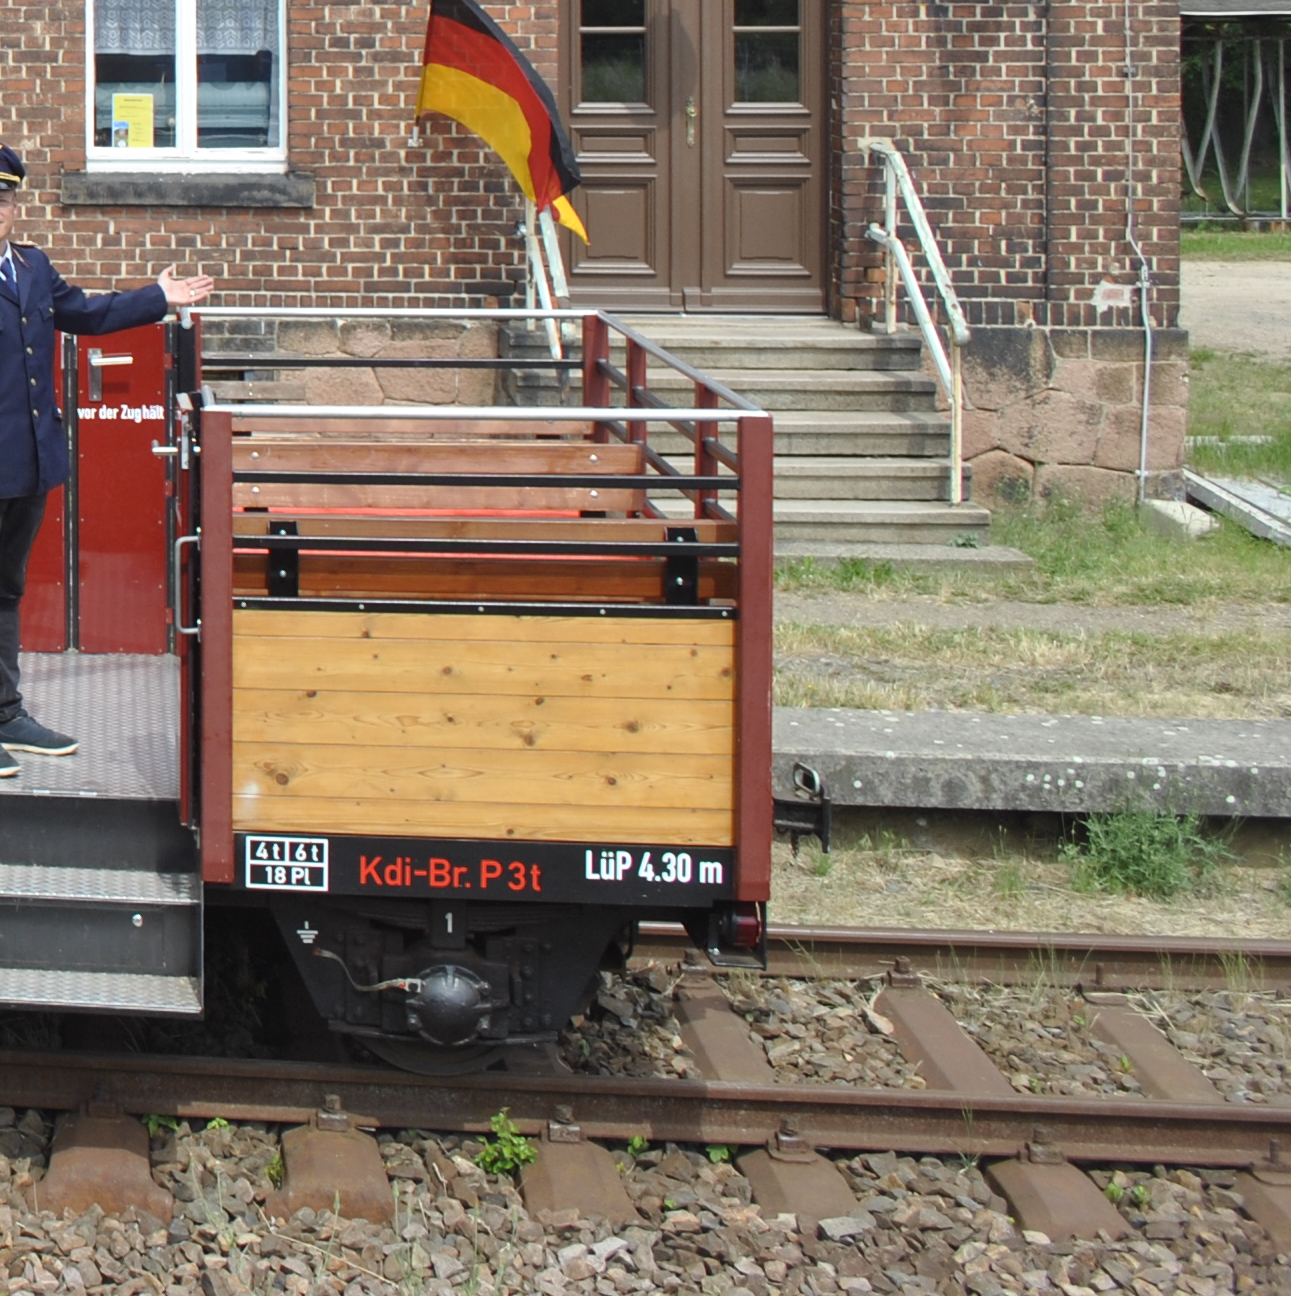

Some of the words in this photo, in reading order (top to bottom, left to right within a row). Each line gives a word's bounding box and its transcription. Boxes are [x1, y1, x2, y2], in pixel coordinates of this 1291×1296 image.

[77, 407, 97, 419] vor
[99, 404, 119, 419] der
[255, 841, 269, 860] 4
[294, 843, 307, 861] 6
[265, 866, 287, 884] 18
[359, 855, 471, 888] Kdi-Br.
[585, 849, 632, 880] LüP
[637, 851, 692, 883] 4.30
[699, 860, 723, 884] m
[445, 912, 453, 933] 1
